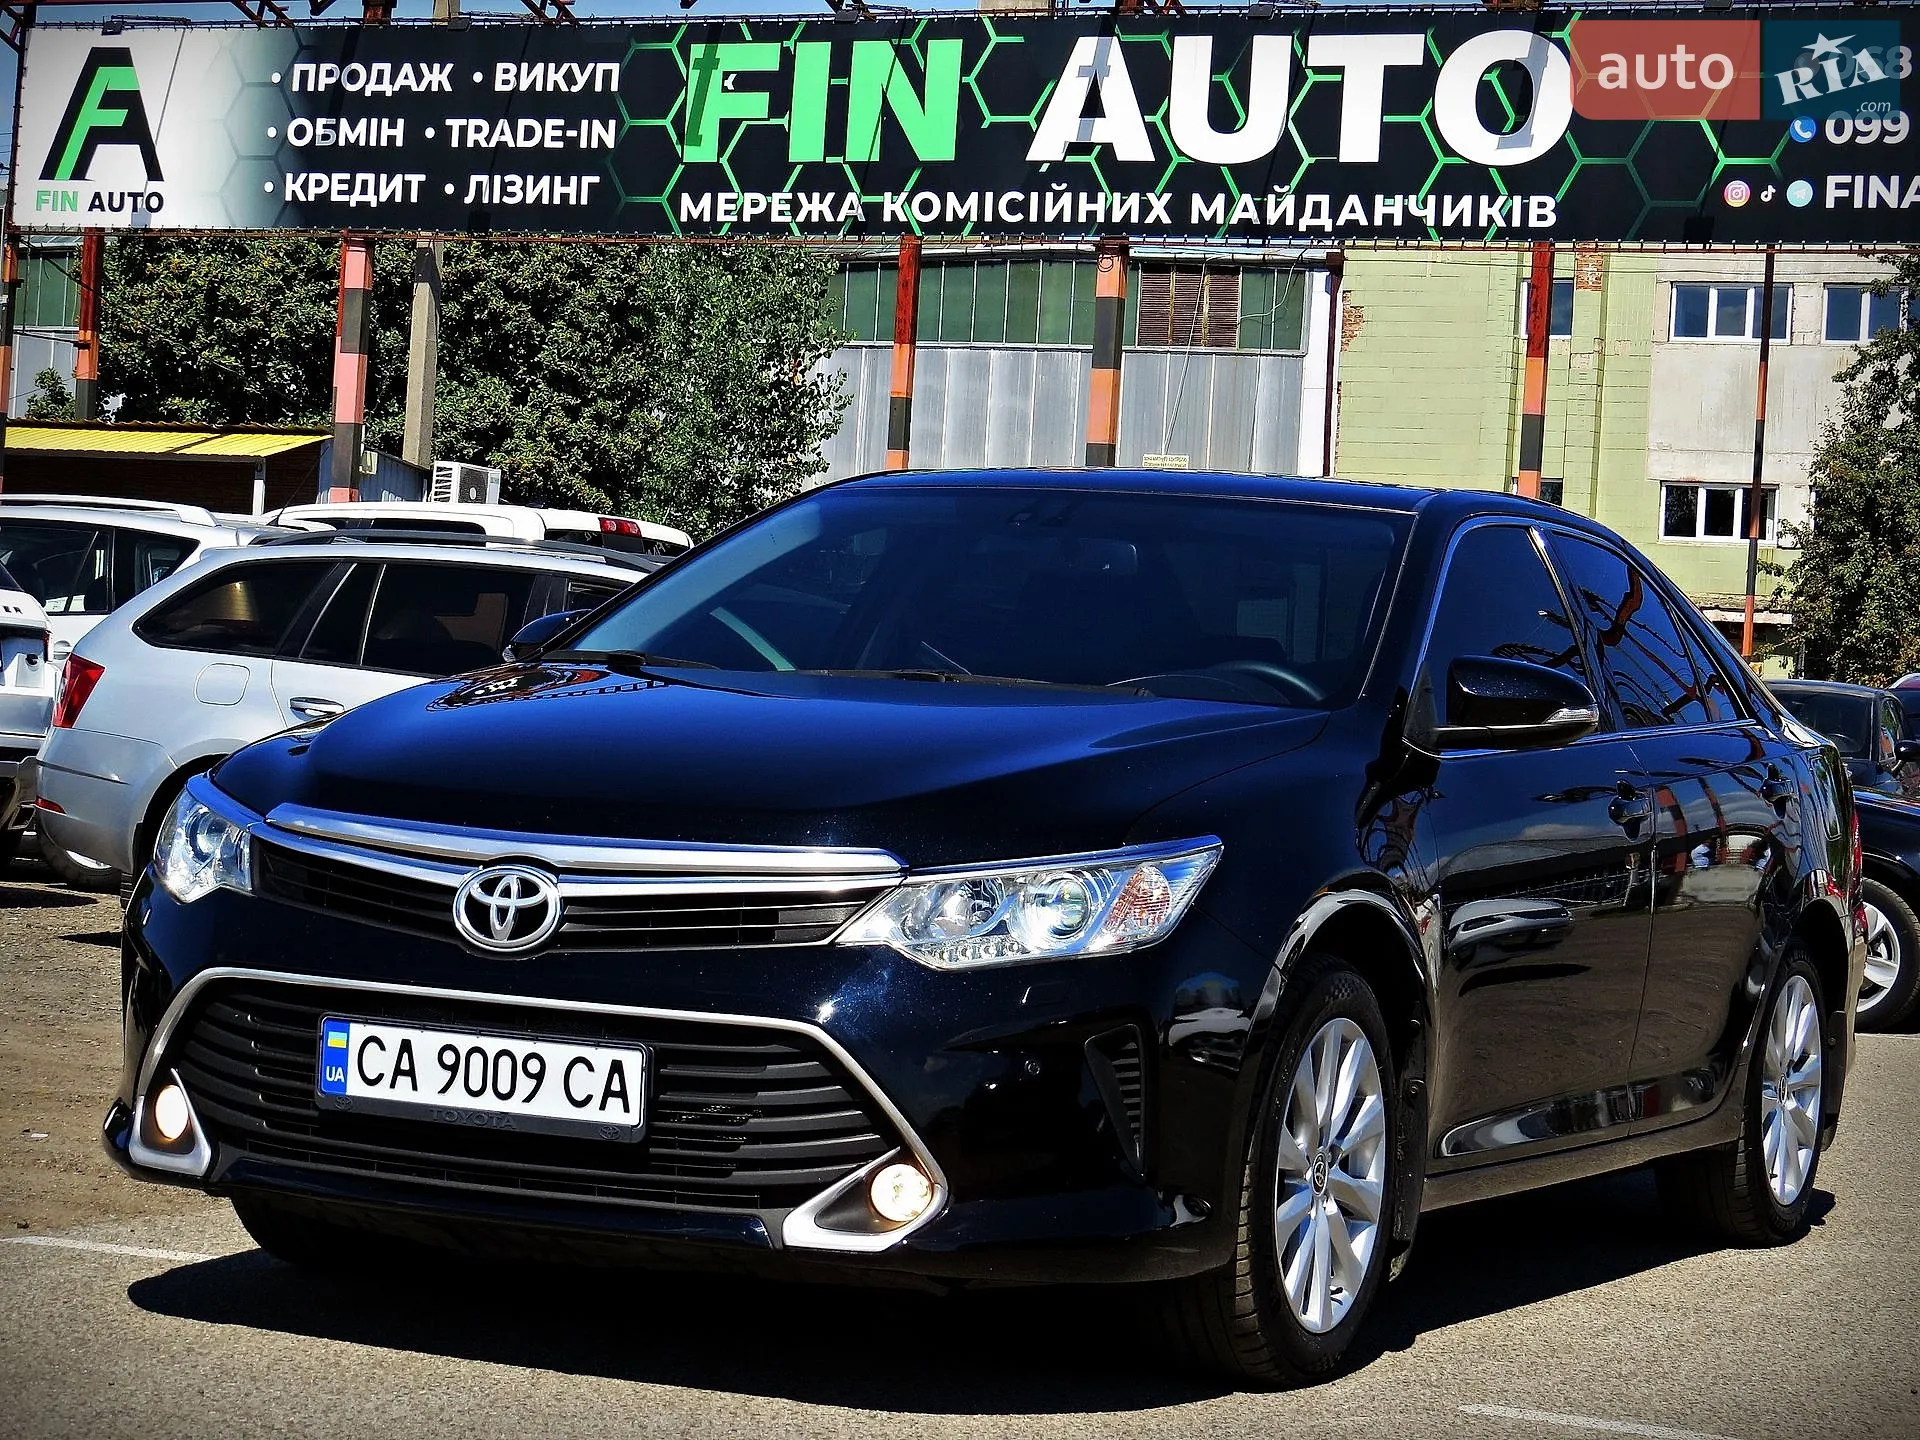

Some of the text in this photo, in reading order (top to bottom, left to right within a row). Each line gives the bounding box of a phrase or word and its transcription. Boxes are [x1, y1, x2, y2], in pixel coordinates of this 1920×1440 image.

[291, 62, 621, 97] ПРОДАЖ ВИКУП
[682, 29, 1572, 166] FIN AUTO
[286, 117, 617, 149] ОБМІН TRADE-IN
[1825, 110, 1910, 145] 099
[36, 190, 165, 214] FIN AUTO
[284, 172, 601, 207] КРЕДИТ ЛІЗИНГ
[680, 183, 1557, 229] МЕРЕЖА КОМІСІЙНИХ МАЙДАНЧИКІВ
[325, 1065, 346, 1084] UA
[356, 1034, 631, 1114] CA 9009 CA
[429, 1107, 517, 1131] TOYOTA
